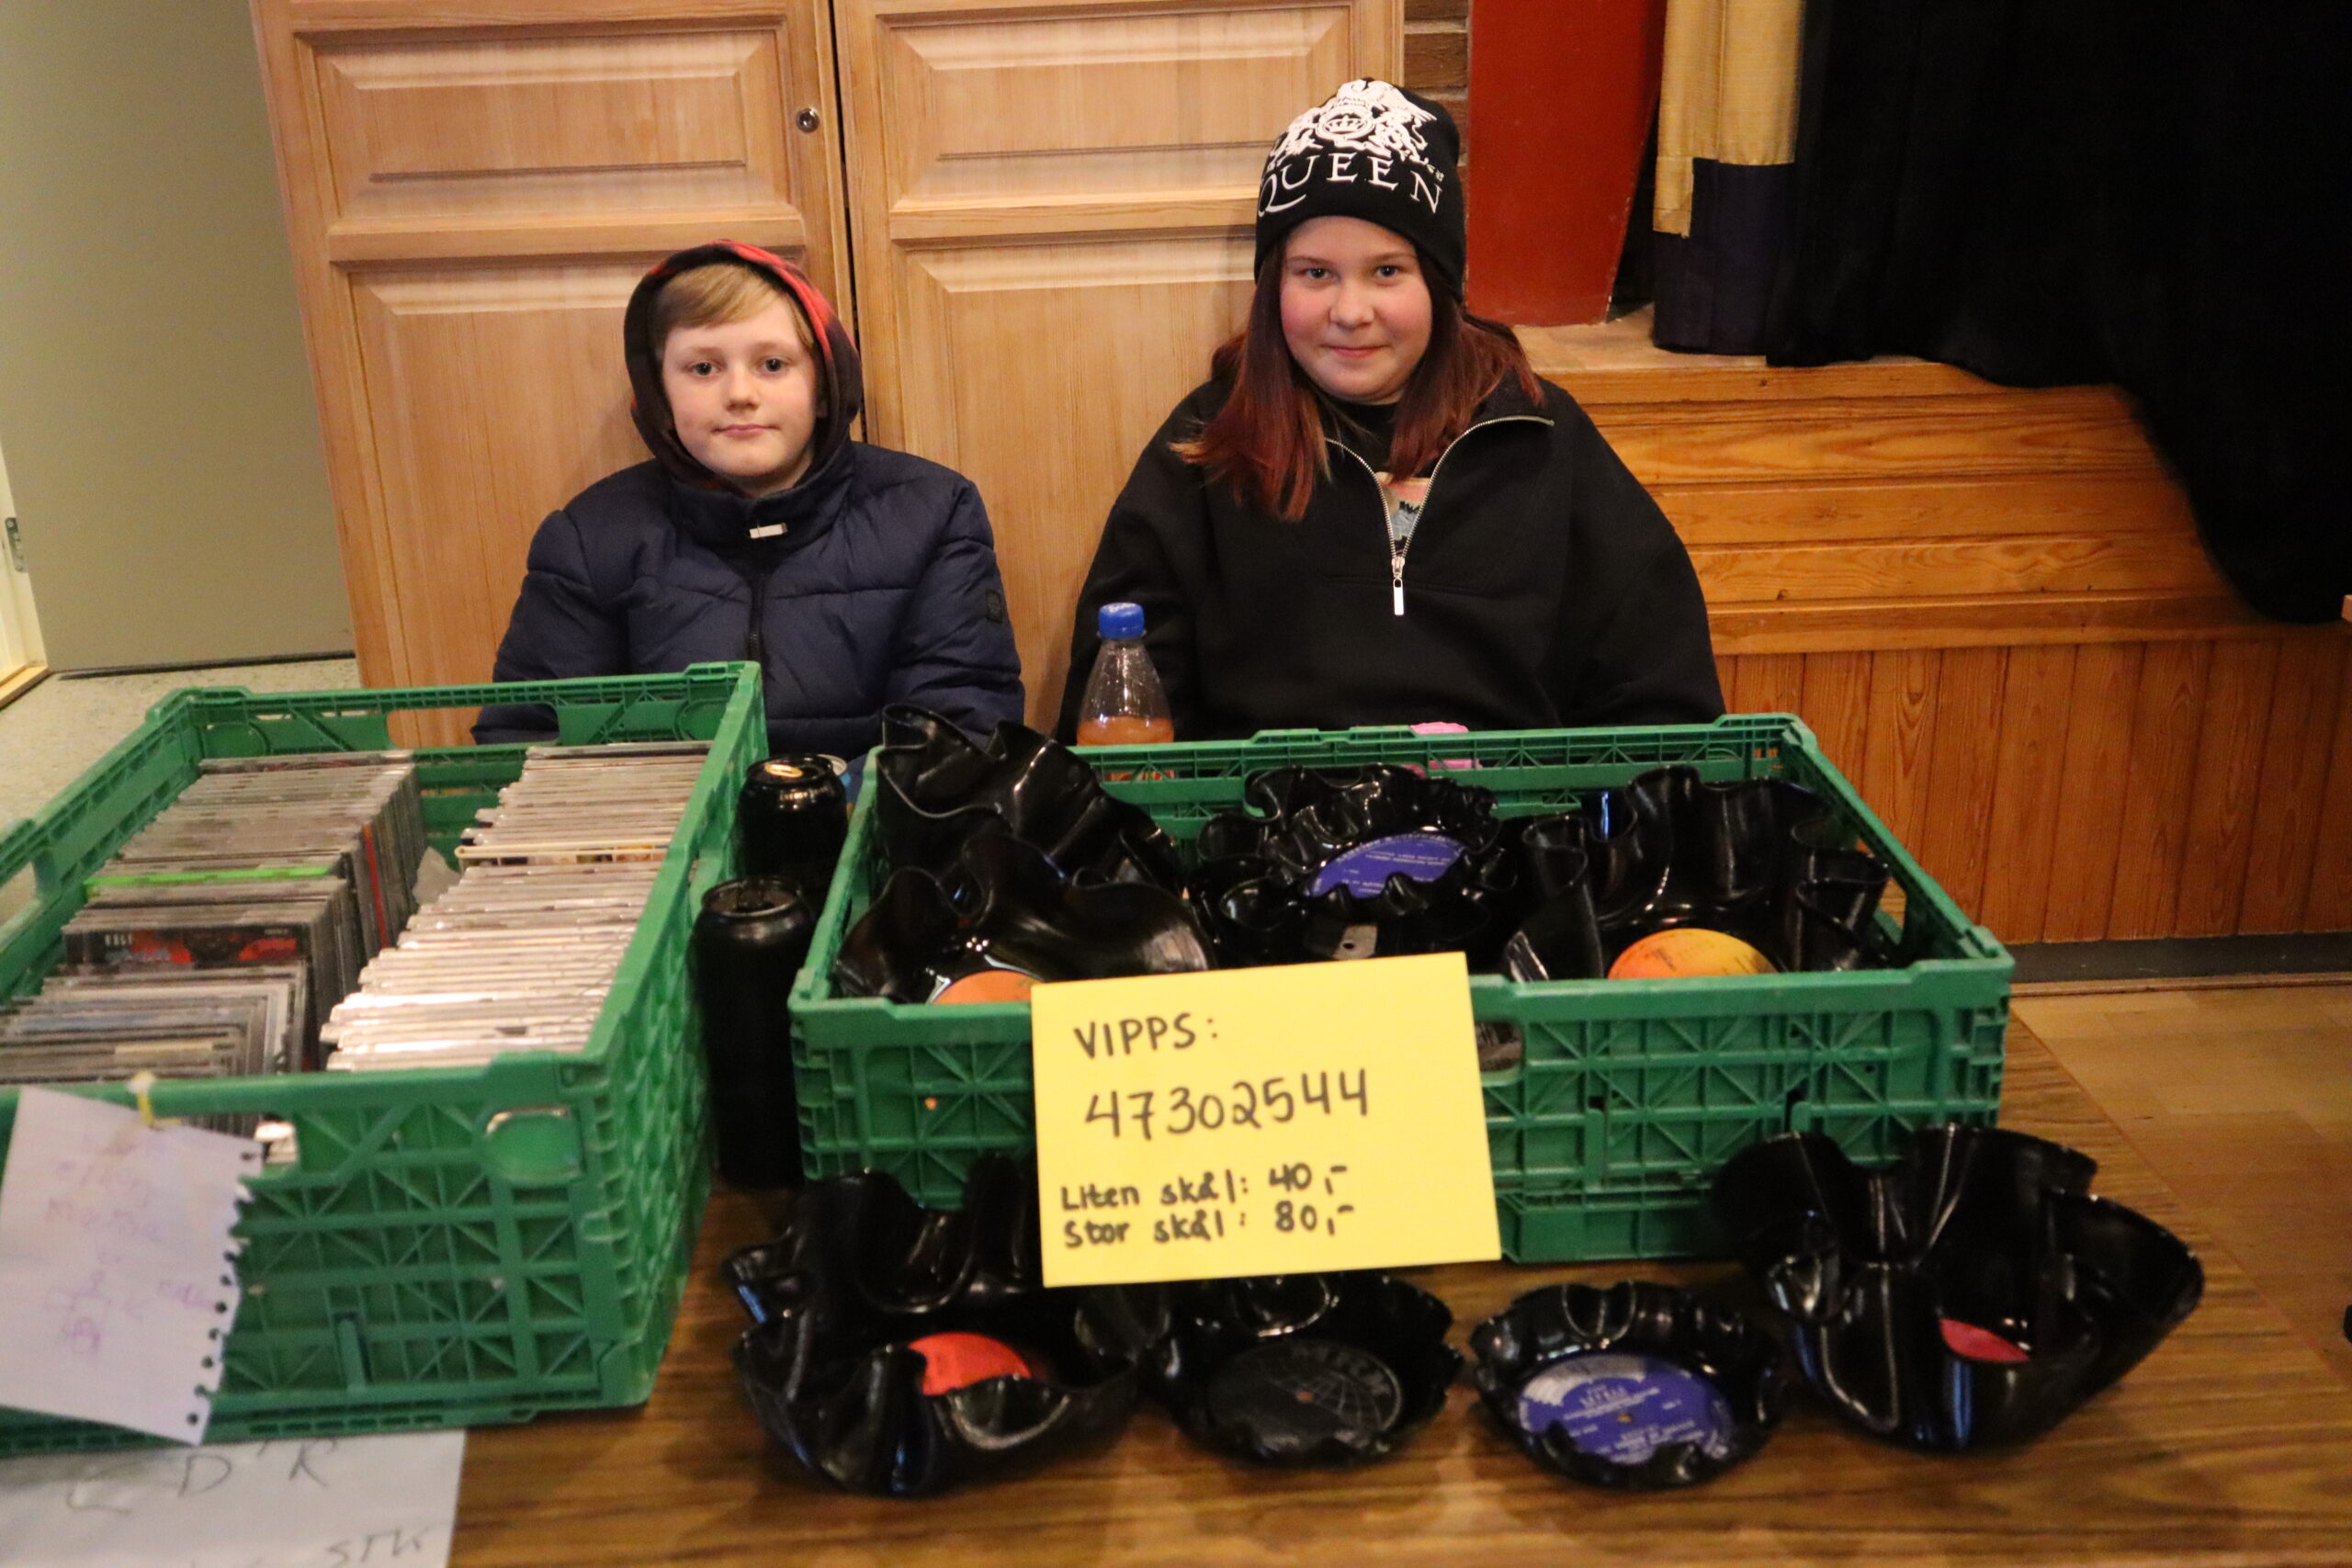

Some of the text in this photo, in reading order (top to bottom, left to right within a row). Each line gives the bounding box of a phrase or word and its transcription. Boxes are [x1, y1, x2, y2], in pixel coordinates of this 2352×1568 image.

[1257, 152, 1443, 217] QUEEN
[1073, 1011, 1218, 1059] VIPPS:
[1085, 1068, 1368, 1141] 47302544
[1061, 1183, 1140, 1212] Liten
[1064, 1220, 1130, 1249] Stor
